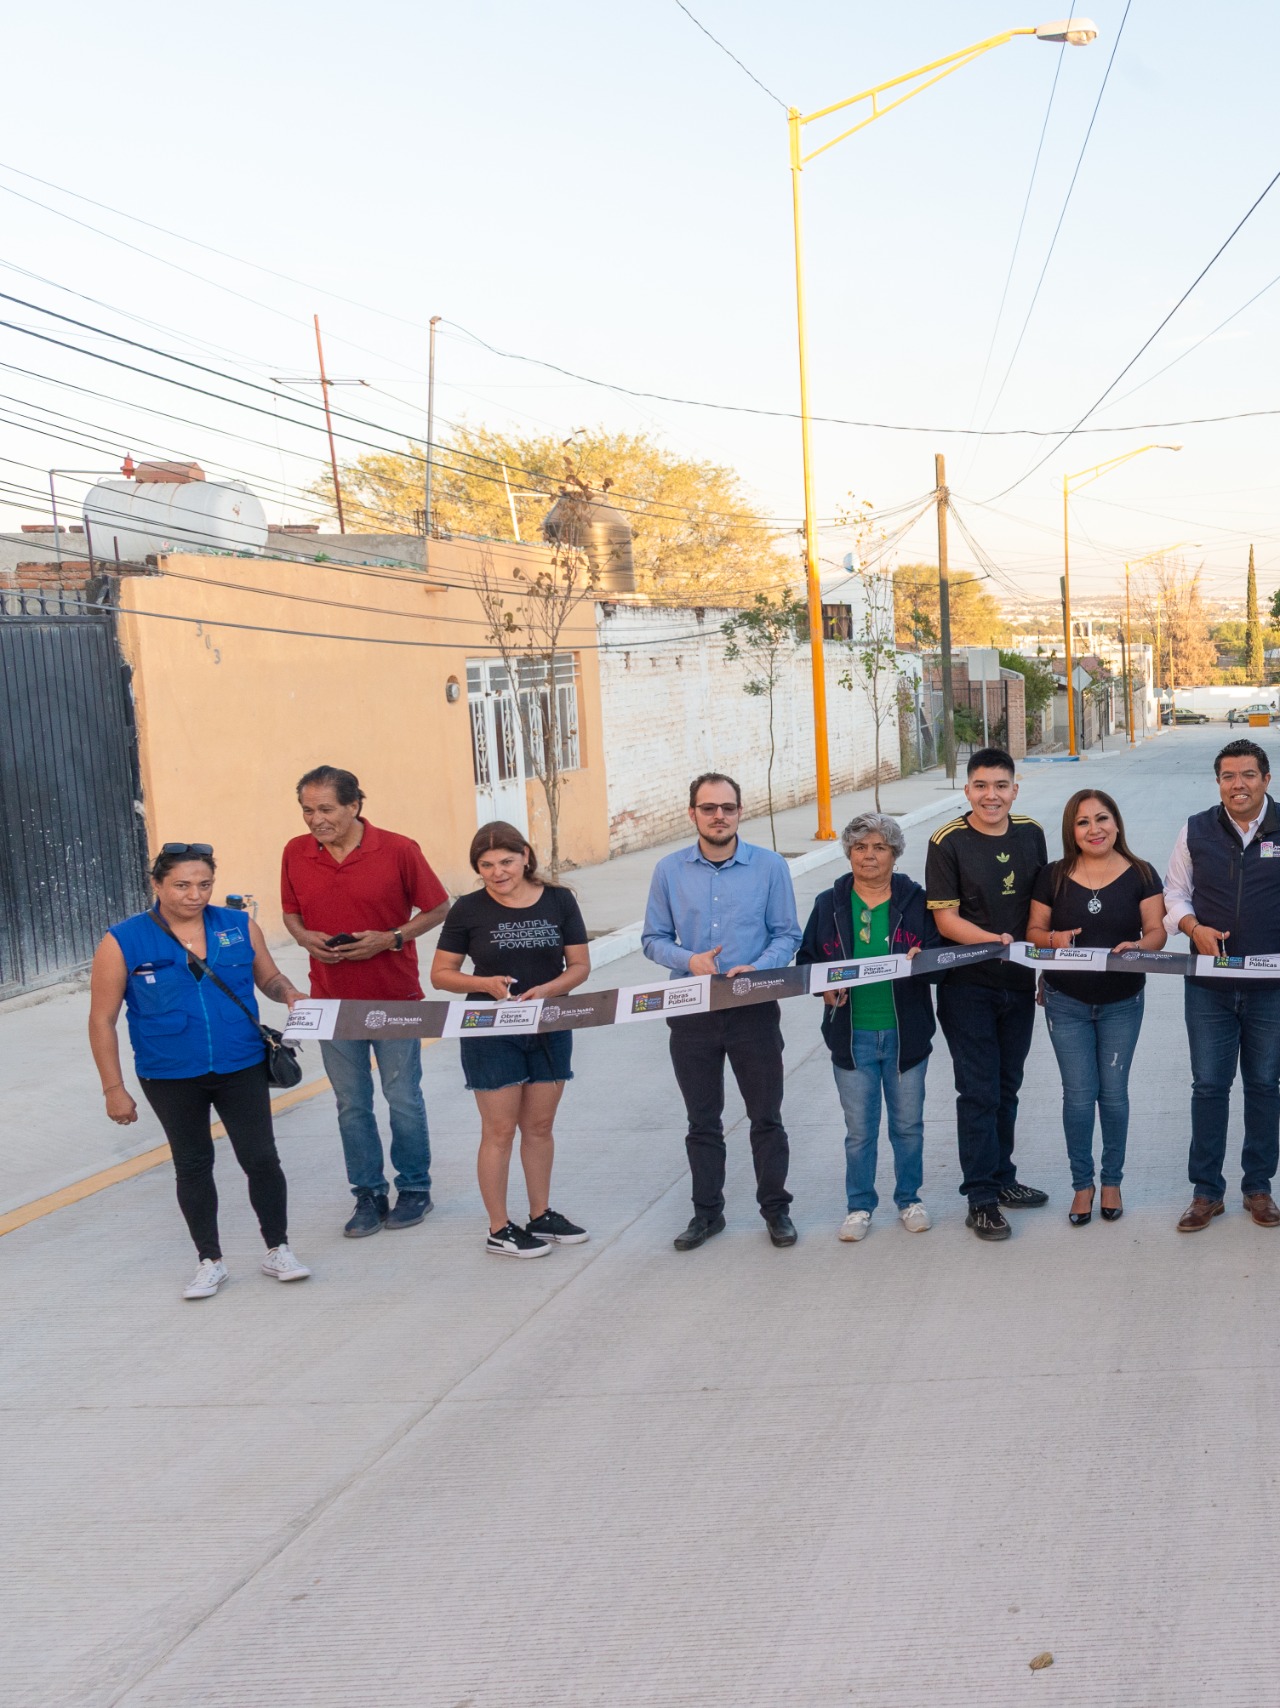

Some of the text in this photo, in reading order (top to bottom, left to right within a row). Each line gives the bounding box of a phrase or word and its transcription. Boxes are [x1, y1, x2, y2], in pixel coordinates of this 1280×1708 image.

[498, 919, 552, 931] BEAUTIFUL
[493, 928, 559, 939] WONDERFUL
[498, 939, 559, 949] POWERFUL
